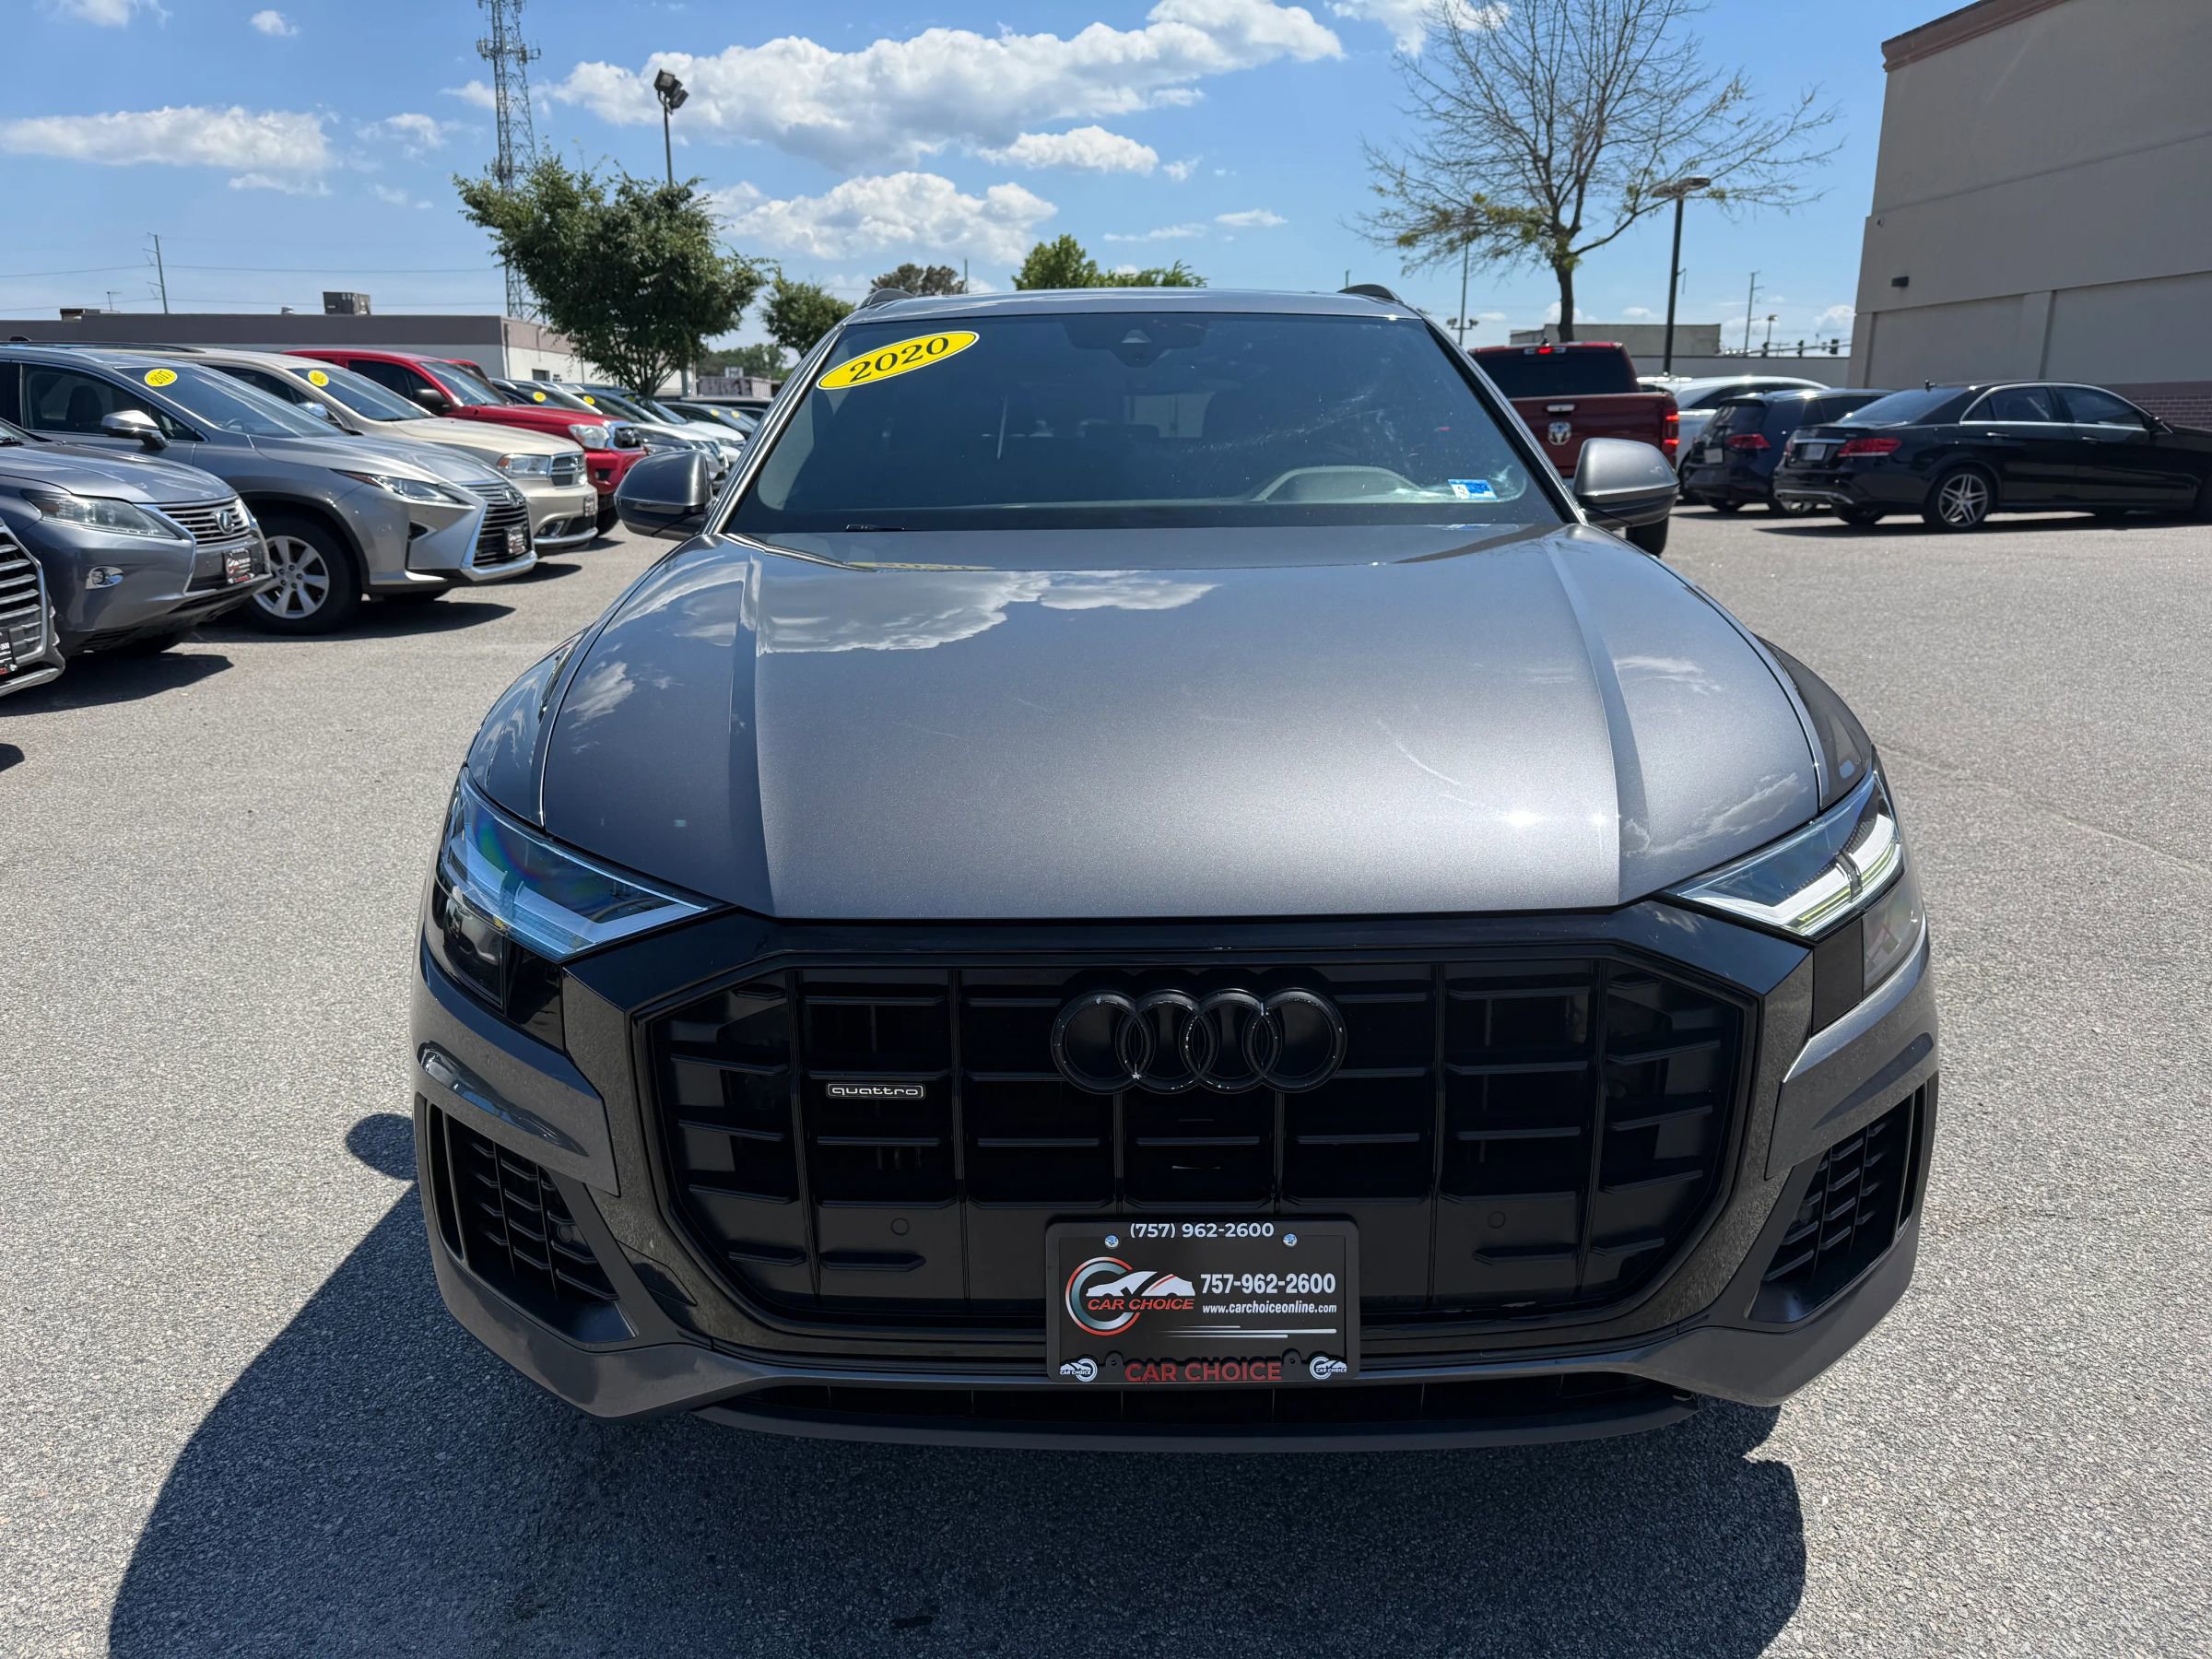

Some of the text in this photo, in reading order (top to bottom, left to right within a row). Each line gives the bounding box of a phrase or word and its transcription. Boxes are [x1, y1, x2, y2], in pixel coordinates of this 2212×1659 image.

[849, 337, 949, 382] 2020
[831, 1087, 919, 1096] quattro
[1130, 1222, 1275, 1239] (757) 962-2600
[1200, 1273, 1336, 1294] 757-962-2600
[1088, 1299, 1195, 1311] CAR CHOICE
[1202, 1300, 1337, 1313] www.carchoiceonline.com
[1124, 1361, 1283, 1382] CAR CHOICE
